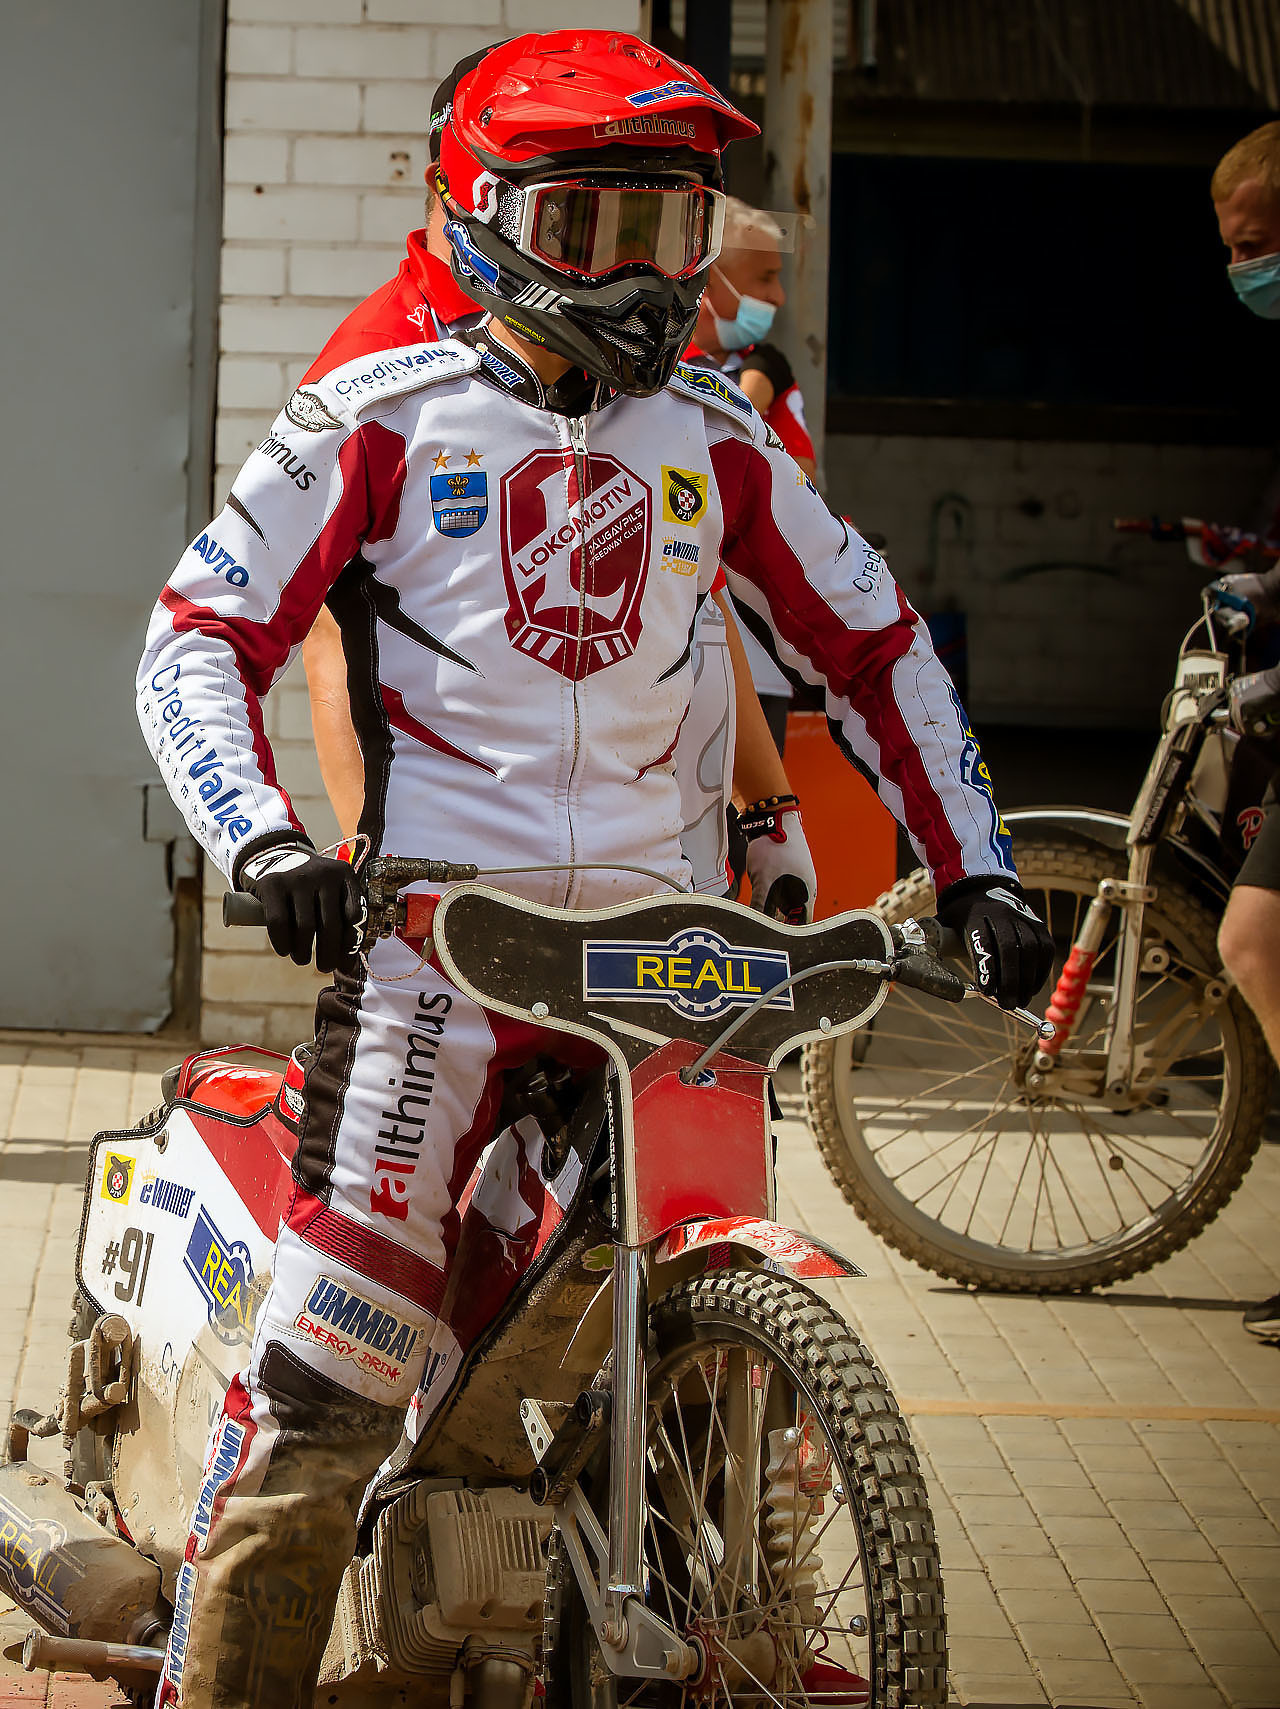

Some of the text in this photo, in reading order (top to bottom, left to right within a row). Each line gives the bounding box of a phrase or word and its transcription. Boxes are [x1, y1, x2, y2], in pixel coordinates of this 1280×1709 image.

[192, 532, 250, 588] AUTO
[516, 477, 632, 578] LOKOMOTIV
[636, 955, 761, 993] REALL
[970, 929, 992, 986] seven
[370, 991, 453, 1222] althimus
[101, 1227, 155, 1308] #91
[201, 1240, 254, 1334] REAL
[296, 1315, 358, 1356] ENERGY
[357, 1351, 401, 1382] DRINK
[307, 1277, 419, 1365] UMMBA!
